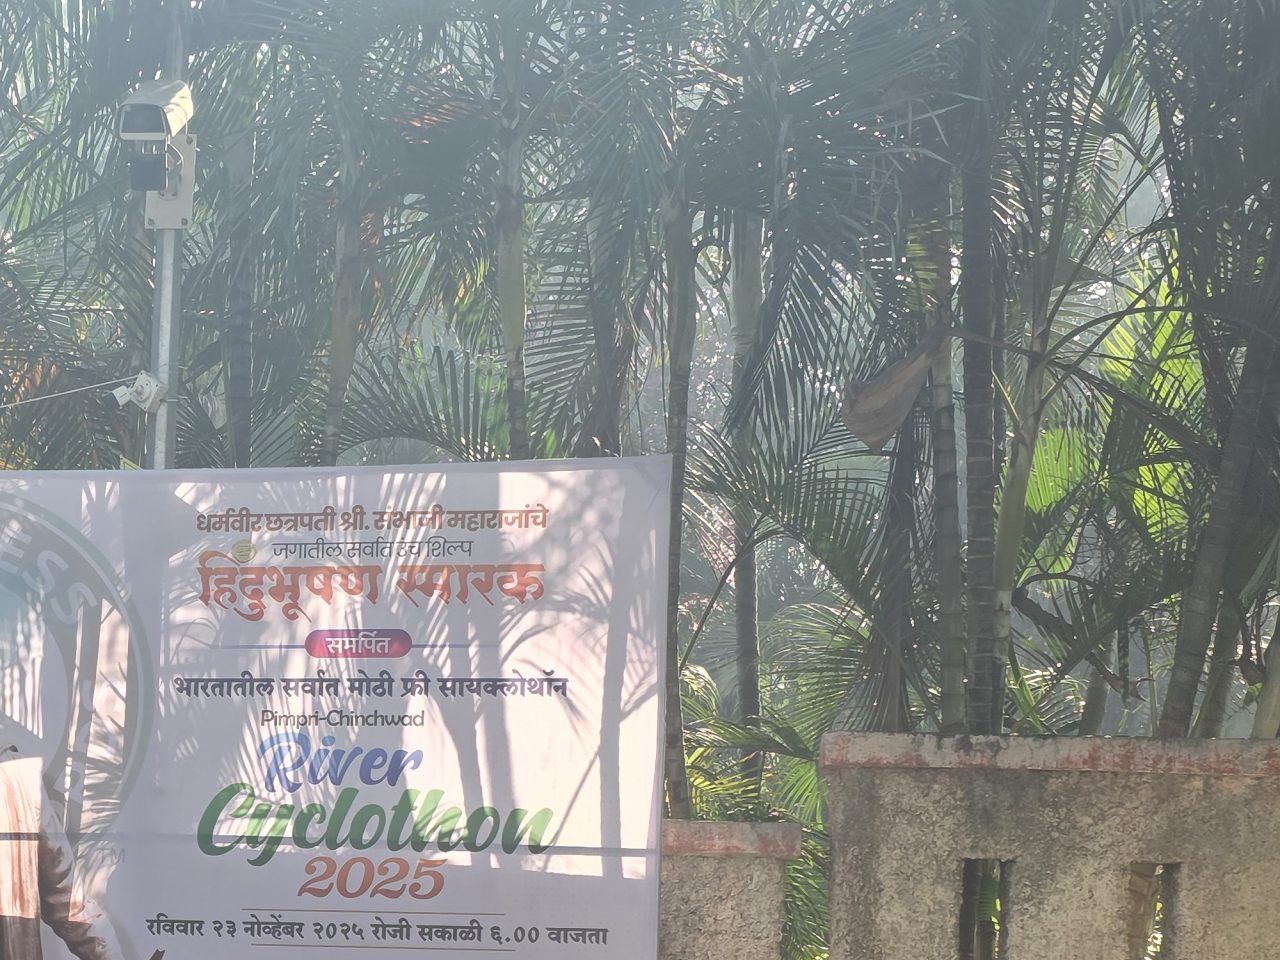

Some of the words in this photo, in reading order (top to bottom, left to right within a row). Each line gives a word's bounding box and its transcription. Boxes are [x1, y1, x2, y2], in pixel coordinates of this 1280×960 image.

[196, 506, 263, 533] धर्मवीर
[264, 505, 337, 532] छत्रपती
[338, 504, 370, 532] श्री.
[372, 503, 445, 531] संभाजी
[447, 503, 550, 532] महाराजांचे
[271, 537, 343, 559] जगातील
[346, 537, 394, 559] सर्वात
[395, 536, 423, 558] उंच
[425, 535, 475, 558] शिल्प
[395, 563, 546, 609] स्मारक
[325, 631, 392, 655] समर्पित
[173, 670, 276, 698] भारतातील
[280, 668, 341, 698] सर्वात
[346, 668, 396, 698] मोठी
[399, 668, 431, 698] फ्री
[436, 668, 570, 698] सायक्लोथॉन
[260, 709, 426, 730] Pimpri-Chinchwad
[256, 731, 424, 793] River
[196, 782, 560, 867] Cyclothon
[297, 855, 448, 900] 2025
[145, 912, 206, 936] रविवार
[212, 919, 238, 938] २३
[241, 912, 306, 941] नोव्हेंबर
[312, 920, 366, 941] २०२५
[369, 915, 413, 941] रोजी
[416, 917, 484, 943] सकाळी
[545, 927, 609, 945] वाजता
